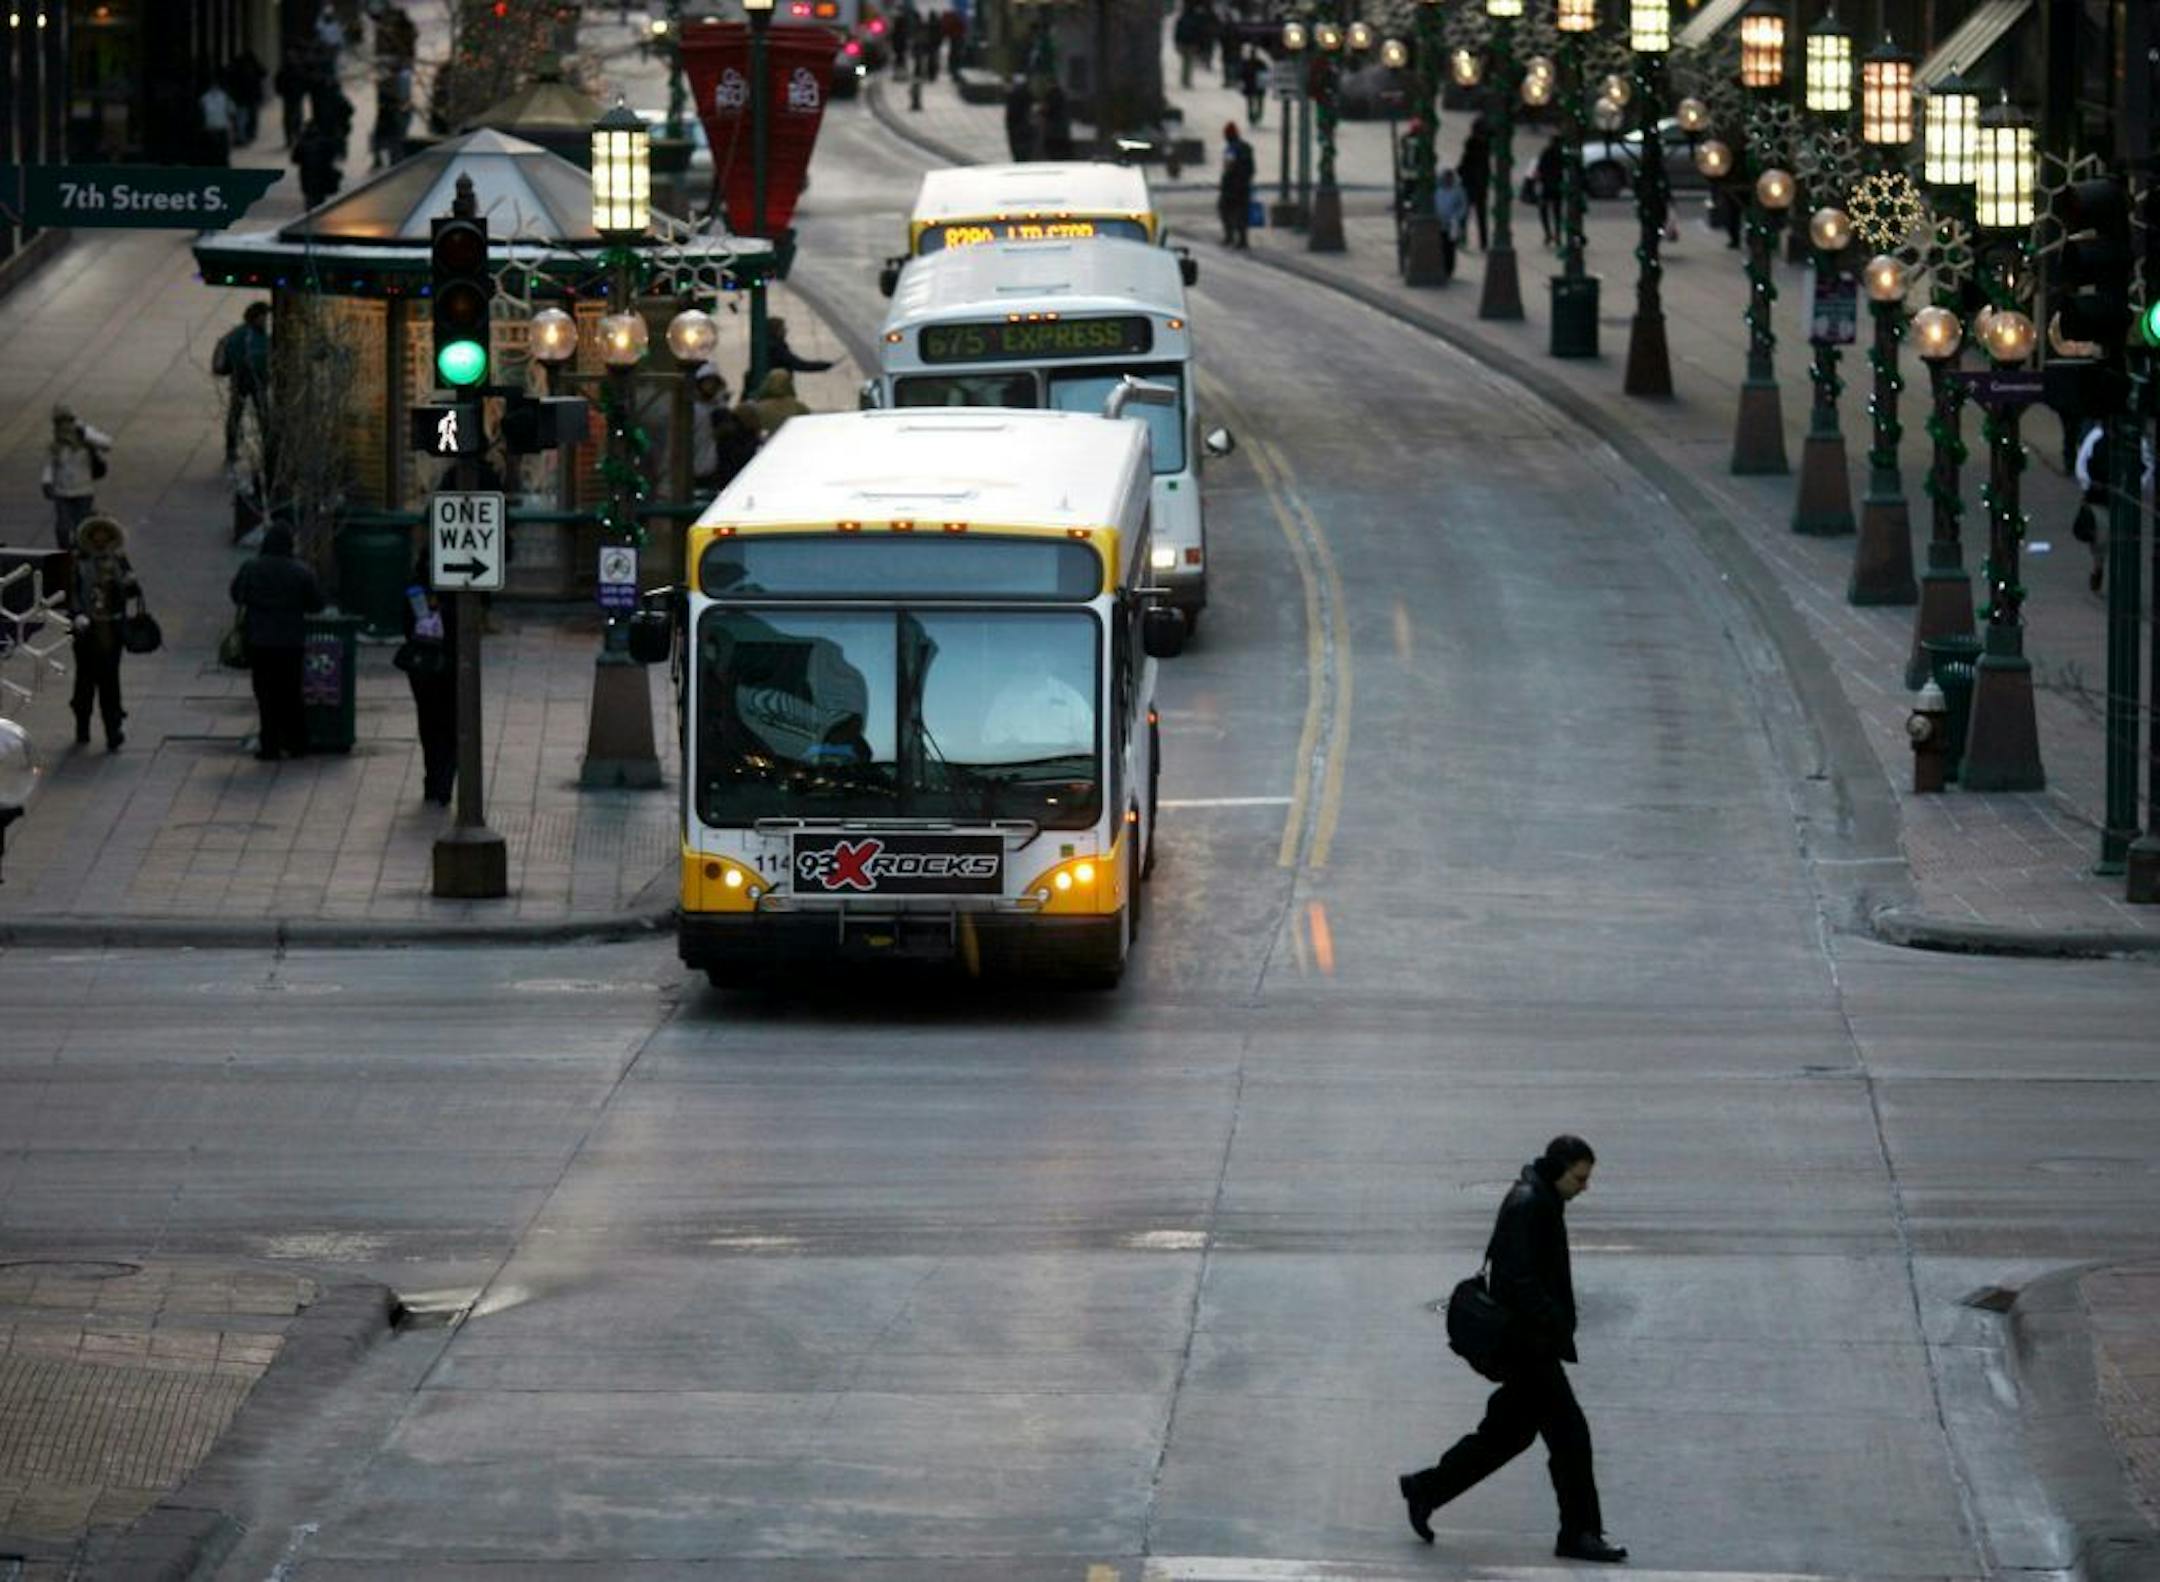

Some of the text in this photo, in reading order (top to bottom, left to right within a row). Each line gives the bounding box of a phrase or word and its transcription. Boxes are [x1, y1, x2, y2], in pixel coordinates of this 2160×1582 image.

[59, 182, 229, 210] 7th Street S.
[927, 322, 1122, 356] 675 EXPRESS
[441, 502, 493, 523] ONE
[440, 528, 494, 550] WAY
[870, 853, 998, 878] ROCKS
